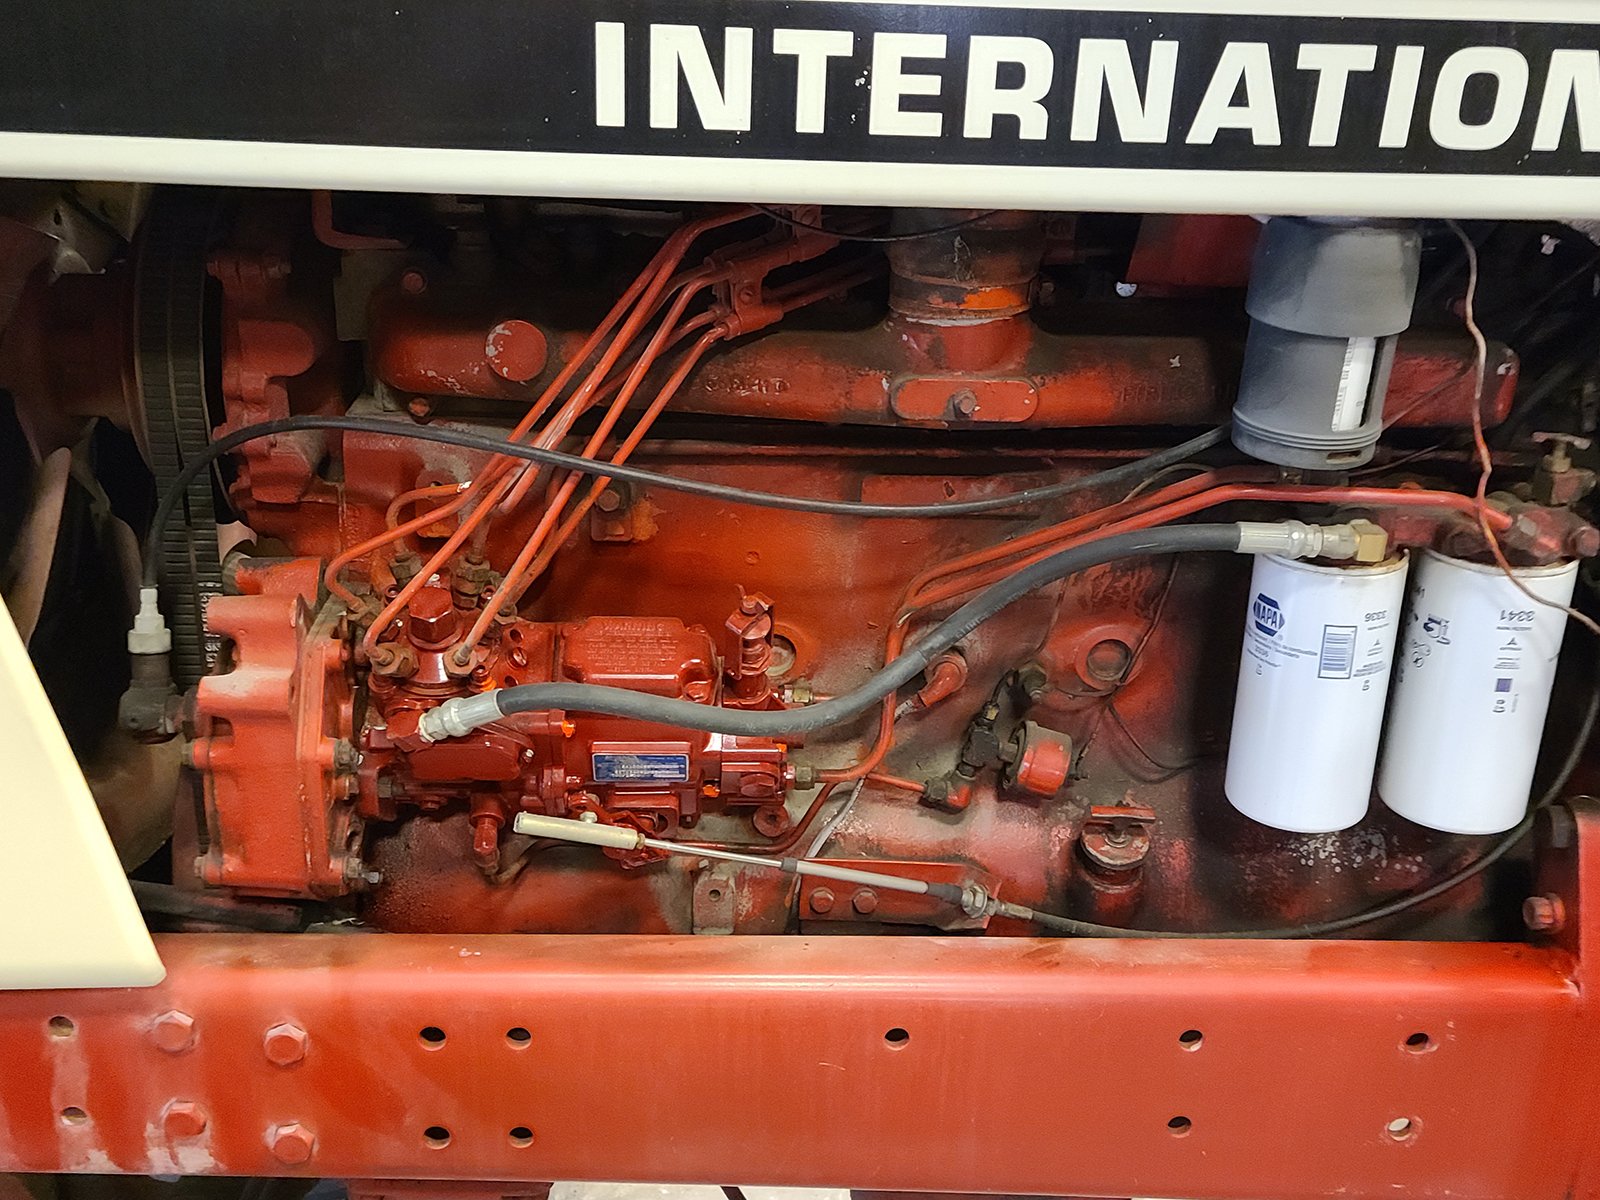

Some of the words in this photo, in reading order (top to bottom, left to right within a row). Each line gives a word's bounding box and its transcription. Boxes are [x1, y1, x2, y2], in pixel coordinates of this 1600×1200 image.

[595, 21, 1600, 153] INTERNATION
[1254, 600, 1279, 629] NAPA
[1364, 609, 1388, 622] 3336
[1499, 609, 1535, 622] 3341
